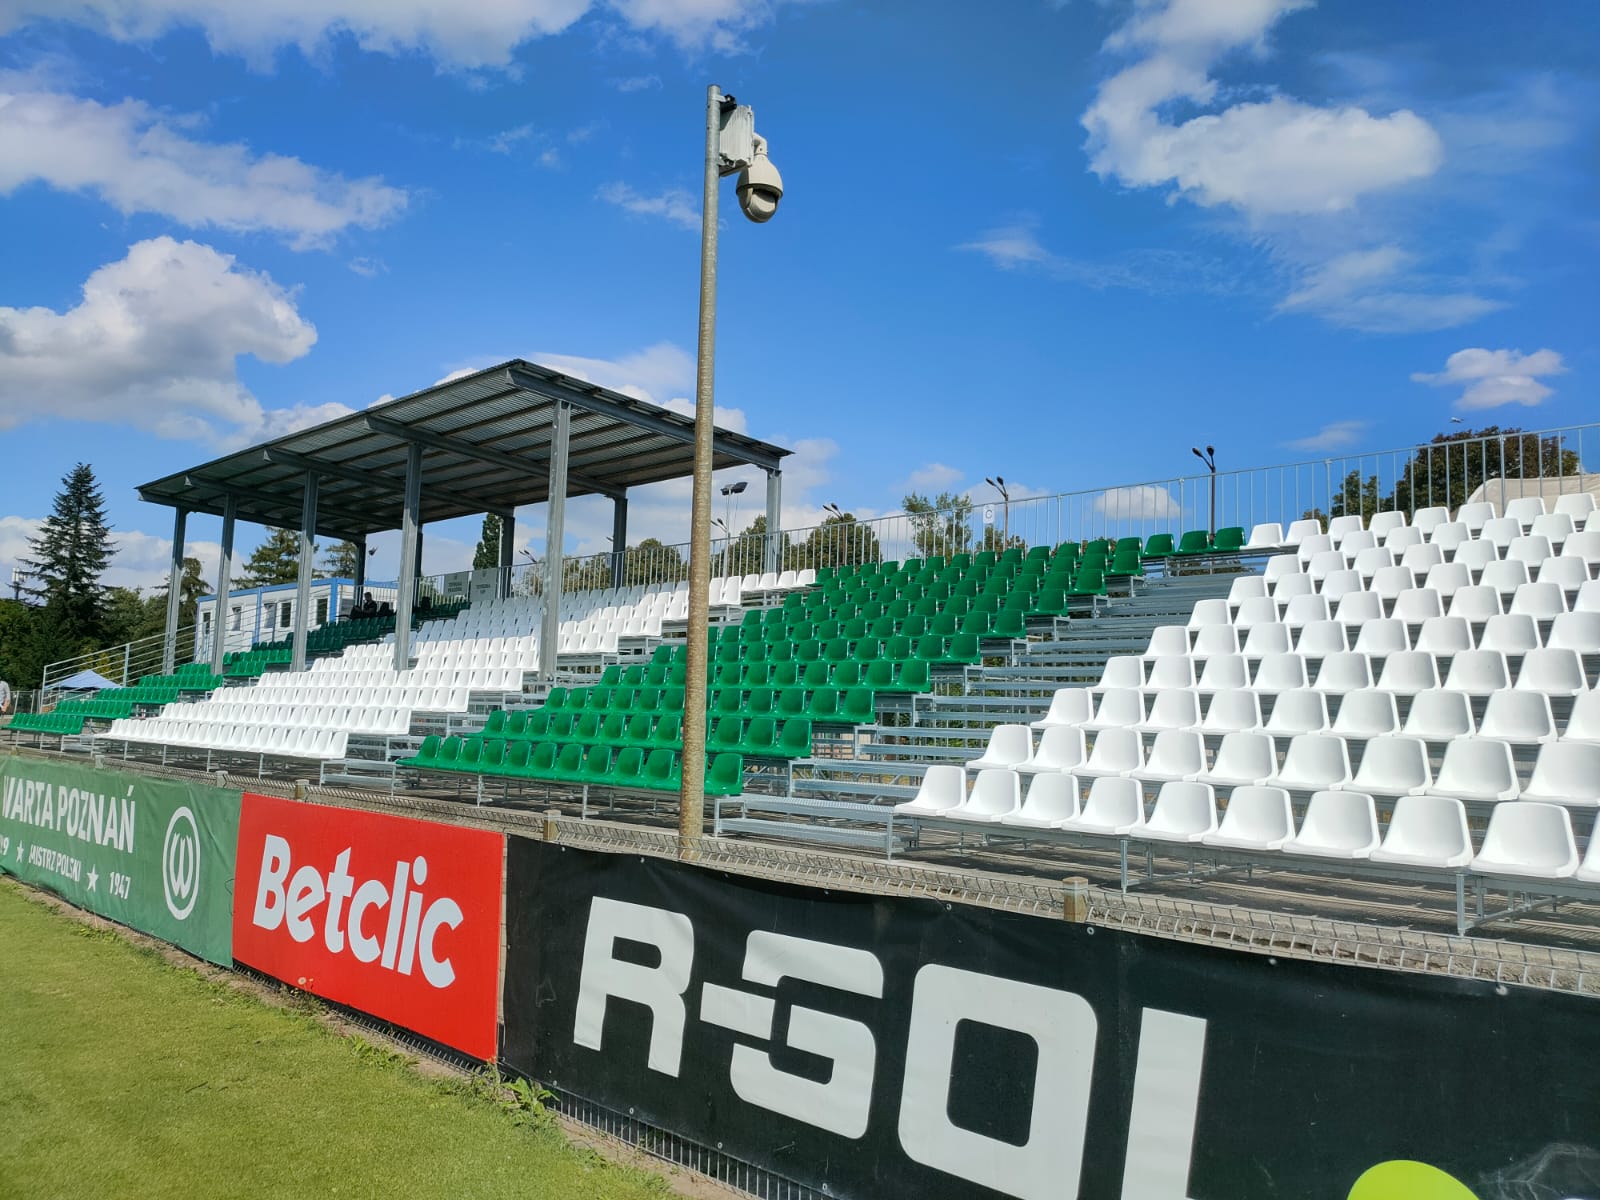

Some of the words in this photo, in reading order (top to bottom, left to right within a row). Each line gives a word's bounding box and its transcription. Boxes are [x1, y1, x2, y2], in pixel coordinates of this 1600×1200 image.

[2, 776, 54, 830] WARTA
[57, 785, 136, 854] POZNAŃ
[28, 844, 57, 872] MISTRZ
[56, 853, 82, 882] POLSKI
[109, 871, 131, 900] 1947
[252, 834, 464, 989] Betclic
